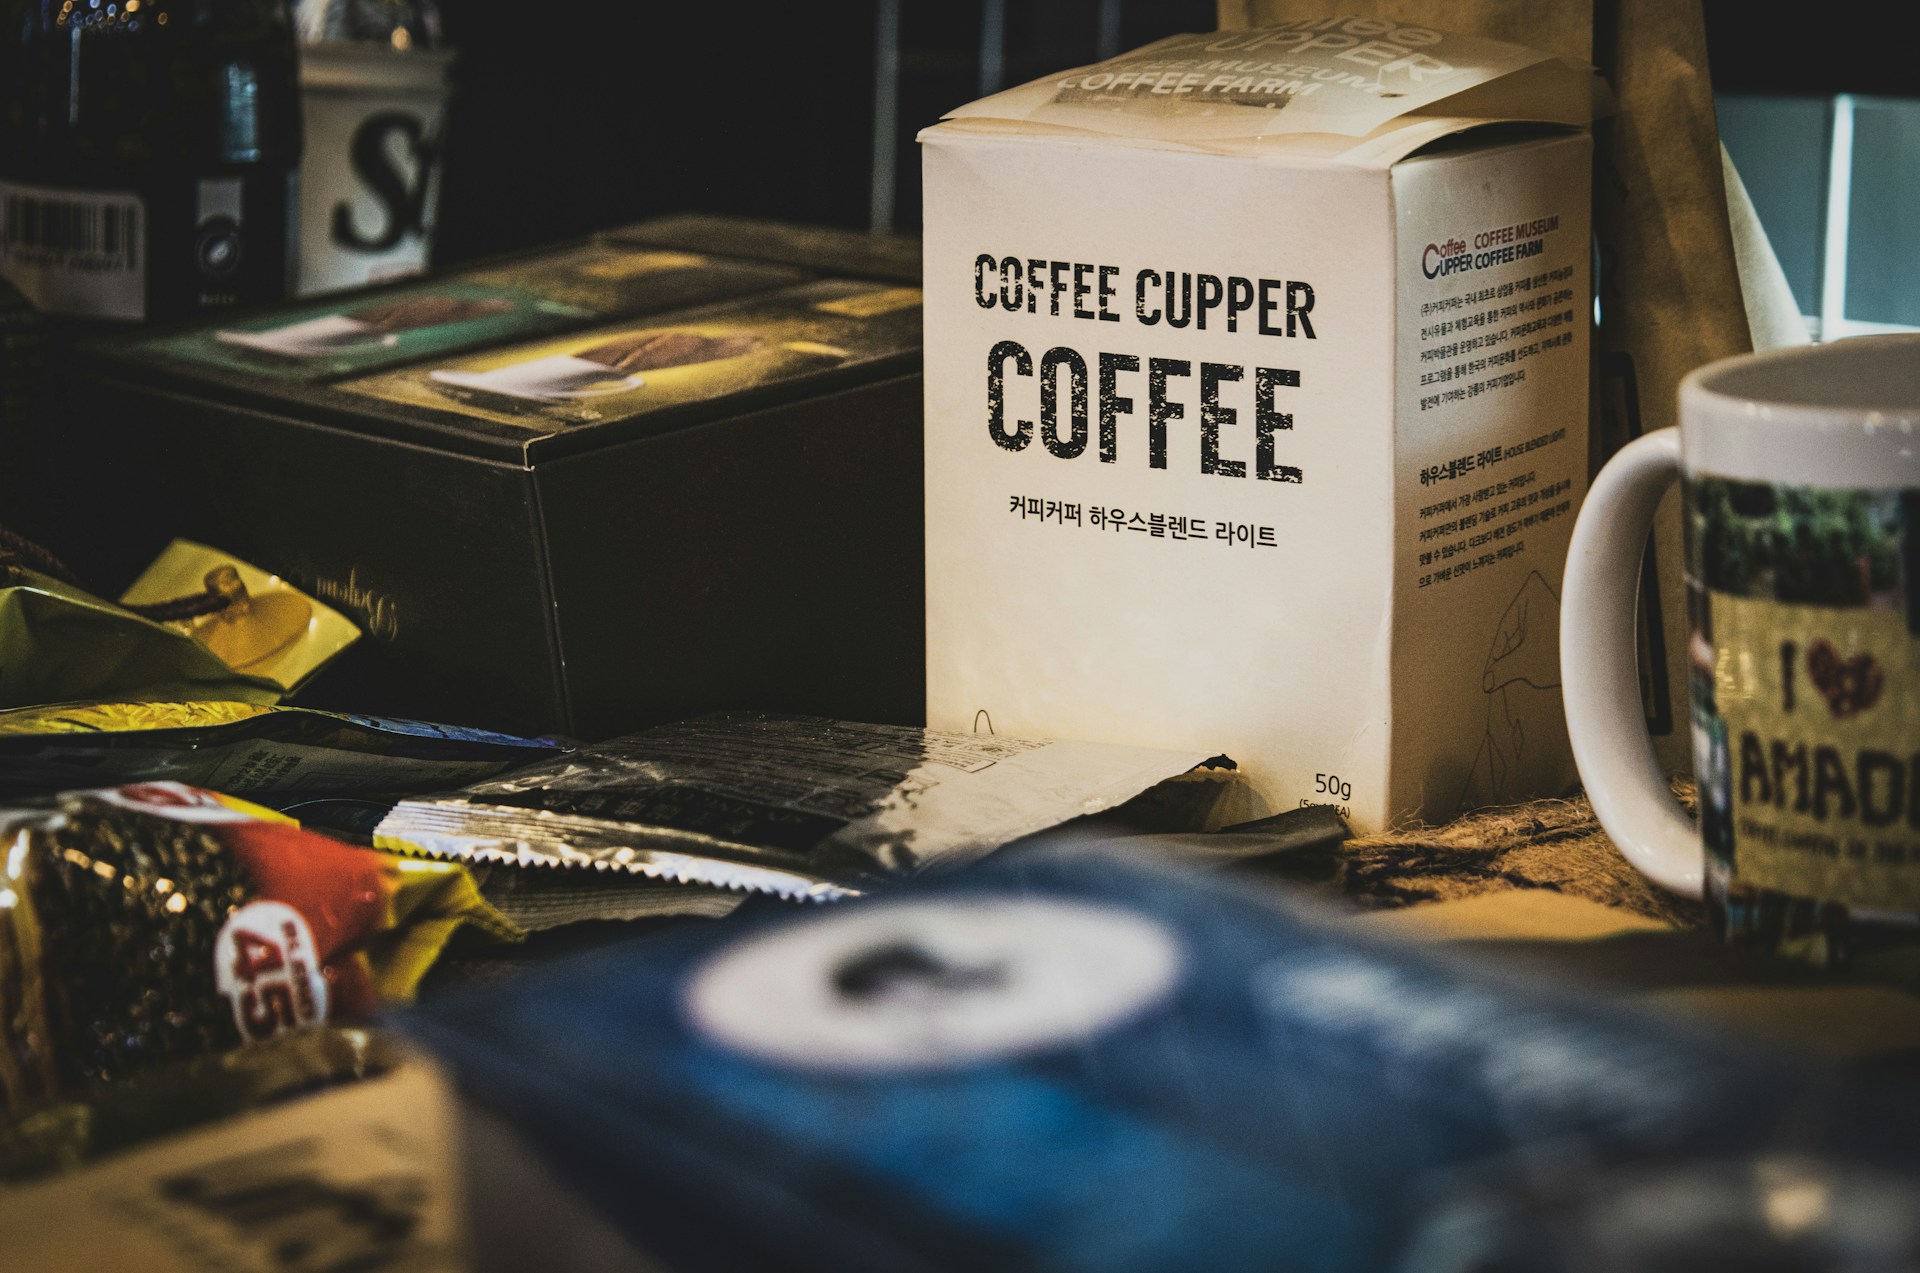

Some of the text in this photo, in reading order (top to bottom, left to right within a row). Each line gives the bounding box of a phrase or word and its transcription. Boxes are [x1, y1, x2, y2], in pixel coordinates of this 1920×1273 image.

[1056, 71, 1324, 97] COFFEE FARM
[1474, 226, 1514, 250] COFFEE
[1515, 215, 1559, 241] MUSEUM
[1475, 244, 1515, 270] COFFEE
[1516, 239, 1544, 260] FARM
[975, 254, 1317, 339] COFFEE CUPPER
[1465, 292, 1477, 305] 국내
[1478, 287, 1496, 302] 최초로
[1487, 309, 1499, 324] 통한
[1500, 304, 1517, 319] 커피의
[1420, 342, 1458, 363] 커피박물관을
[1460, 336, 1484, 353] 운영하고
[1420, 367, 1453, 386] 프로그램을
[1468, 358, 1486, 375] 한국의
[987, 340, 1303, 484] COFFEE
[1420, 455, 1476, 487] 하우스블렌드
[1477, 446, 1503, 470] 라이트
[1010, 495, 1278, 549] 커피커퍼 하우스블렌드 라이트
[1433, 549, 1440, 561] 수
[1418, 574, 1432, 588] 으로
[1780, 638, 1796, 715] I
[1315, 773, 1351, 801] 50g
